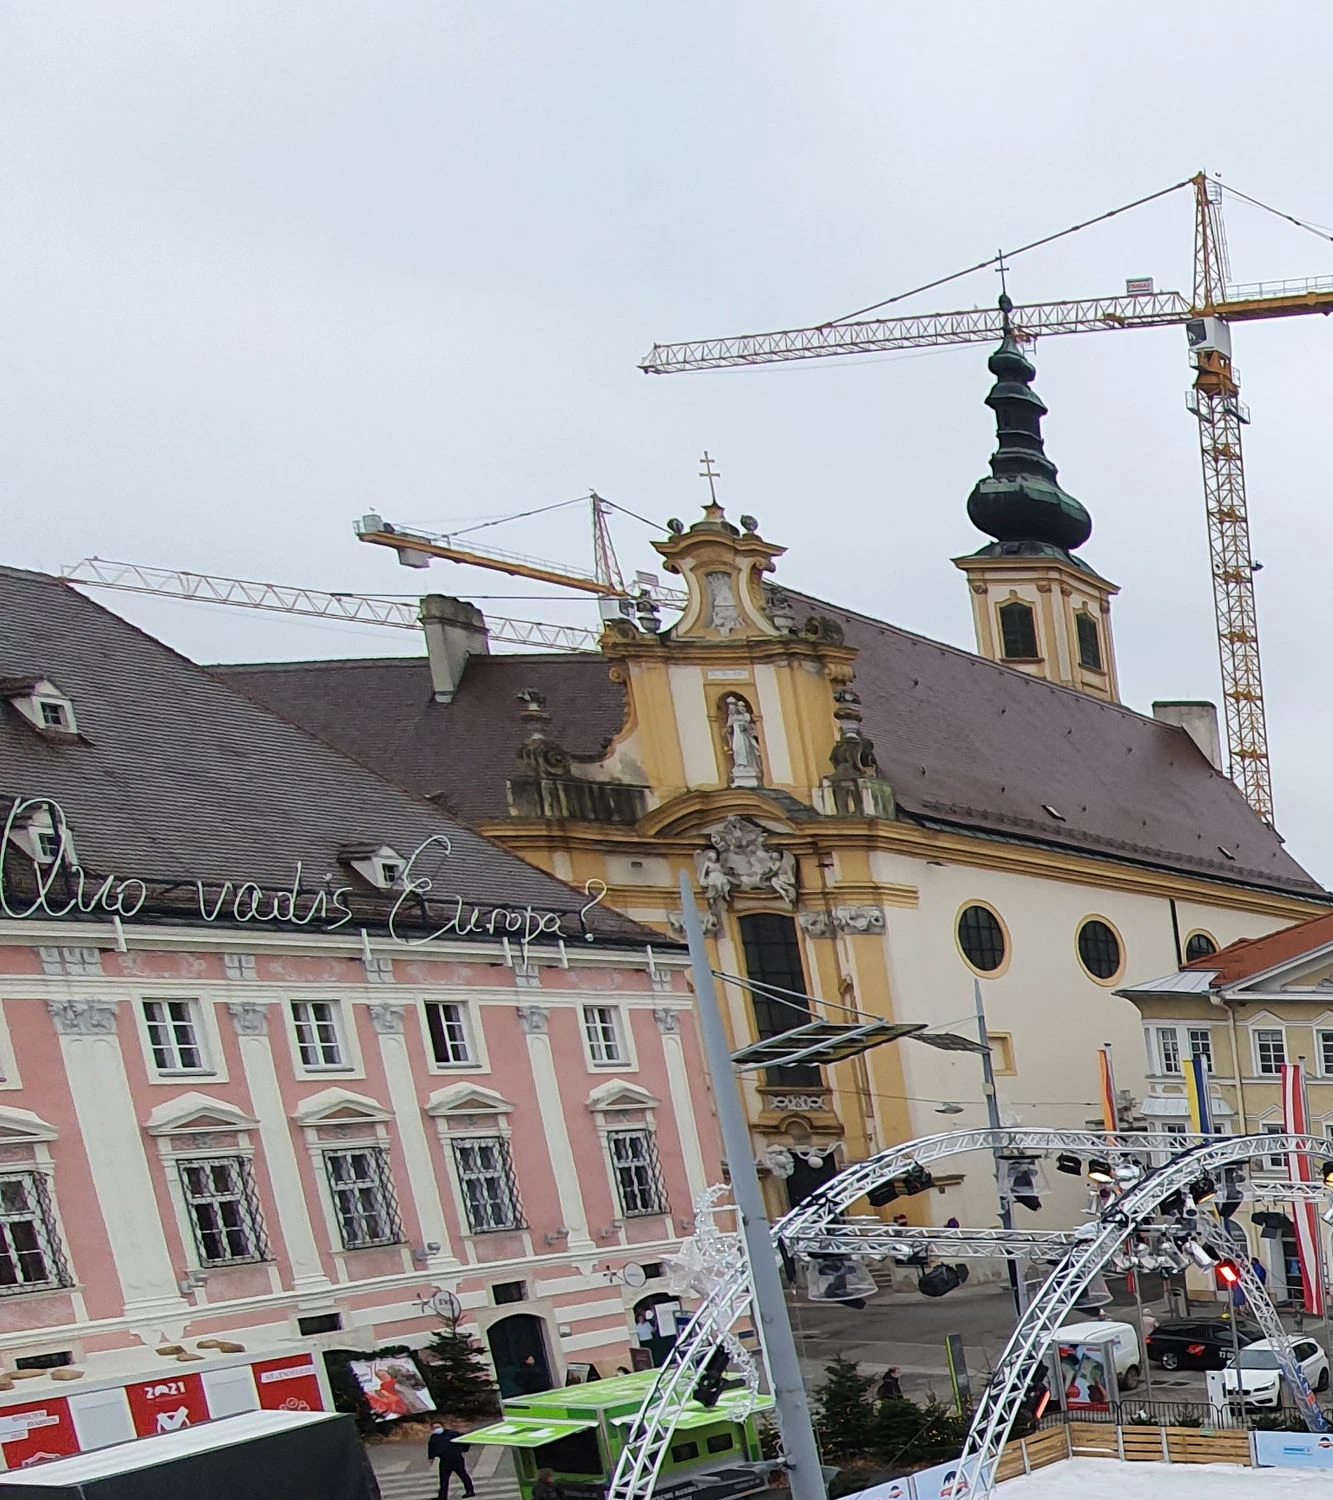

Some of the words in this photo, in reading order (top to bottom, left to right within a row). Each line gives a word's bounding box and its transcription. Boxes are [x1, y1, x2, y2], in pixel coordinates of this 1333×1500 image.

[0, 798, 146, 918] Quo
[197, 860, 353, 930] vadis
[389, 835, 568, 971] Europa
[580, 878, 607, 942] ?
